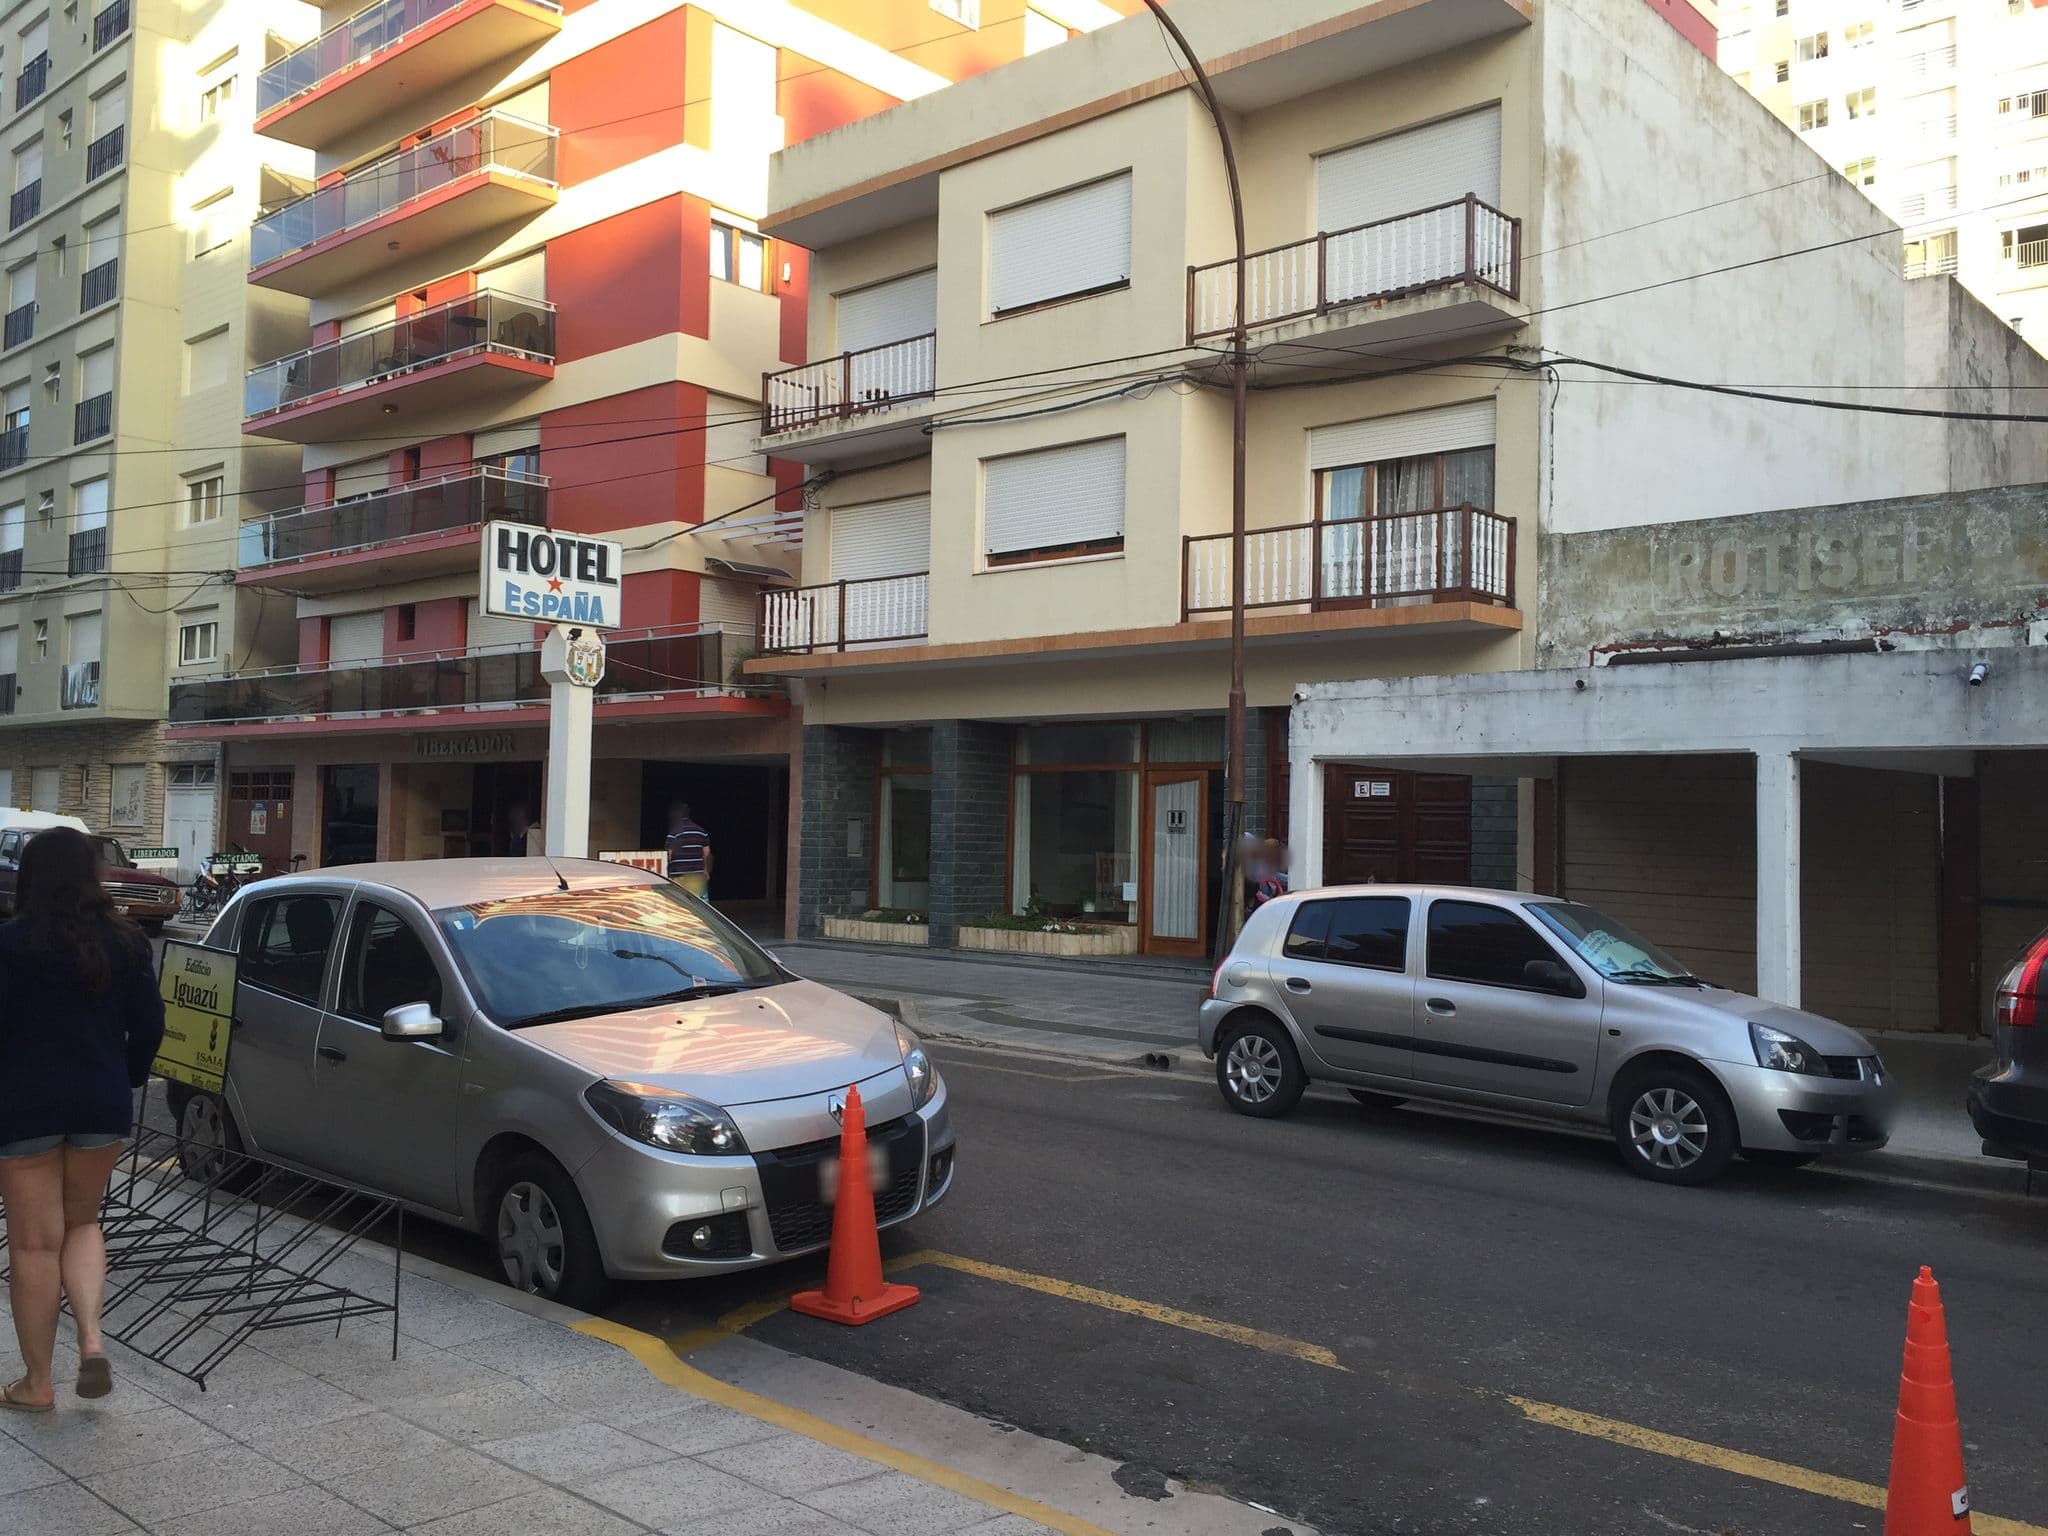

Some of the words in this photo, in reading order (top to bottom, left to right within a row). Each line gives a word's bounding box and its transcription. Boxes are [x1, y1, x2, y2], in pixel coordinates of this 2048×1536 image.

[497, 528, 618, 586] HOTEL
[504, 580, 605, 624] ESPAÑA
[133, 849, 176, 858] LIBERTADOR
[184, 957, 212, 977] Edificio
[173, 974, 218, 1010] Iguazú
[196, 1051, 223, 1068] ISAIA
